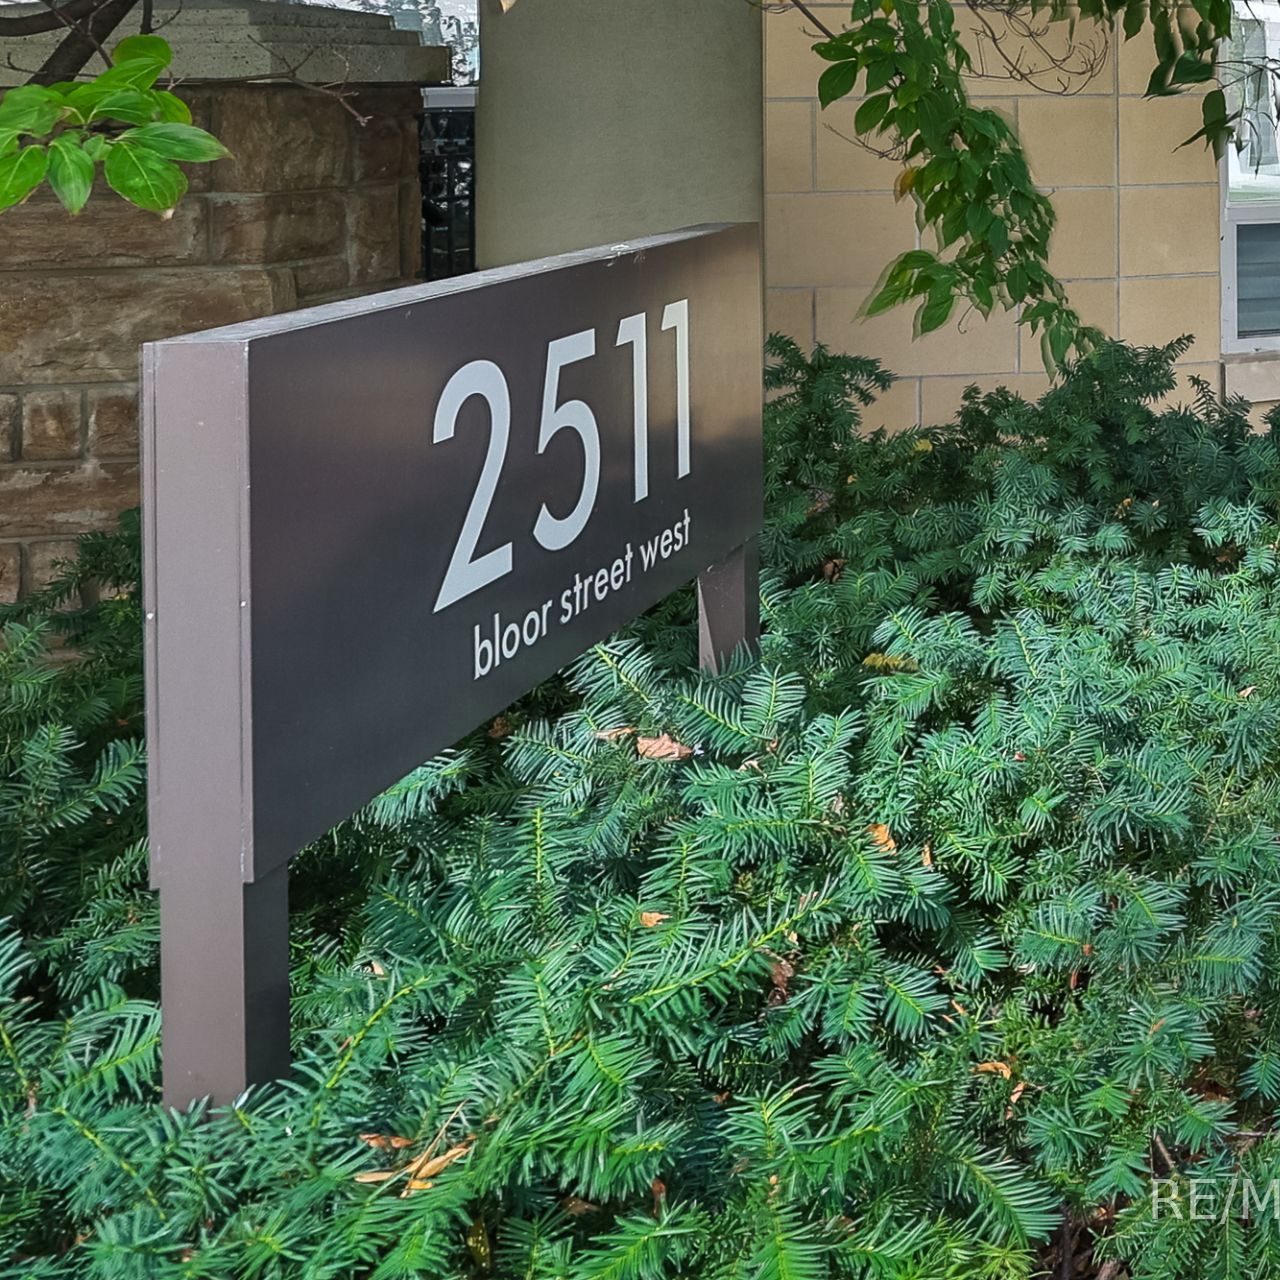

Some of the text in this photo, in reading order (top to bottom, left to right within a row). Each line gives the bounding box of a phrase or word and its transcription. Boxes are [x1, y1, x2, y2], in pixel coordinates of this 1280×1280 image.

[432, 298, 691, 614] 2511
[473, 508, 691, 681] bloor street west
